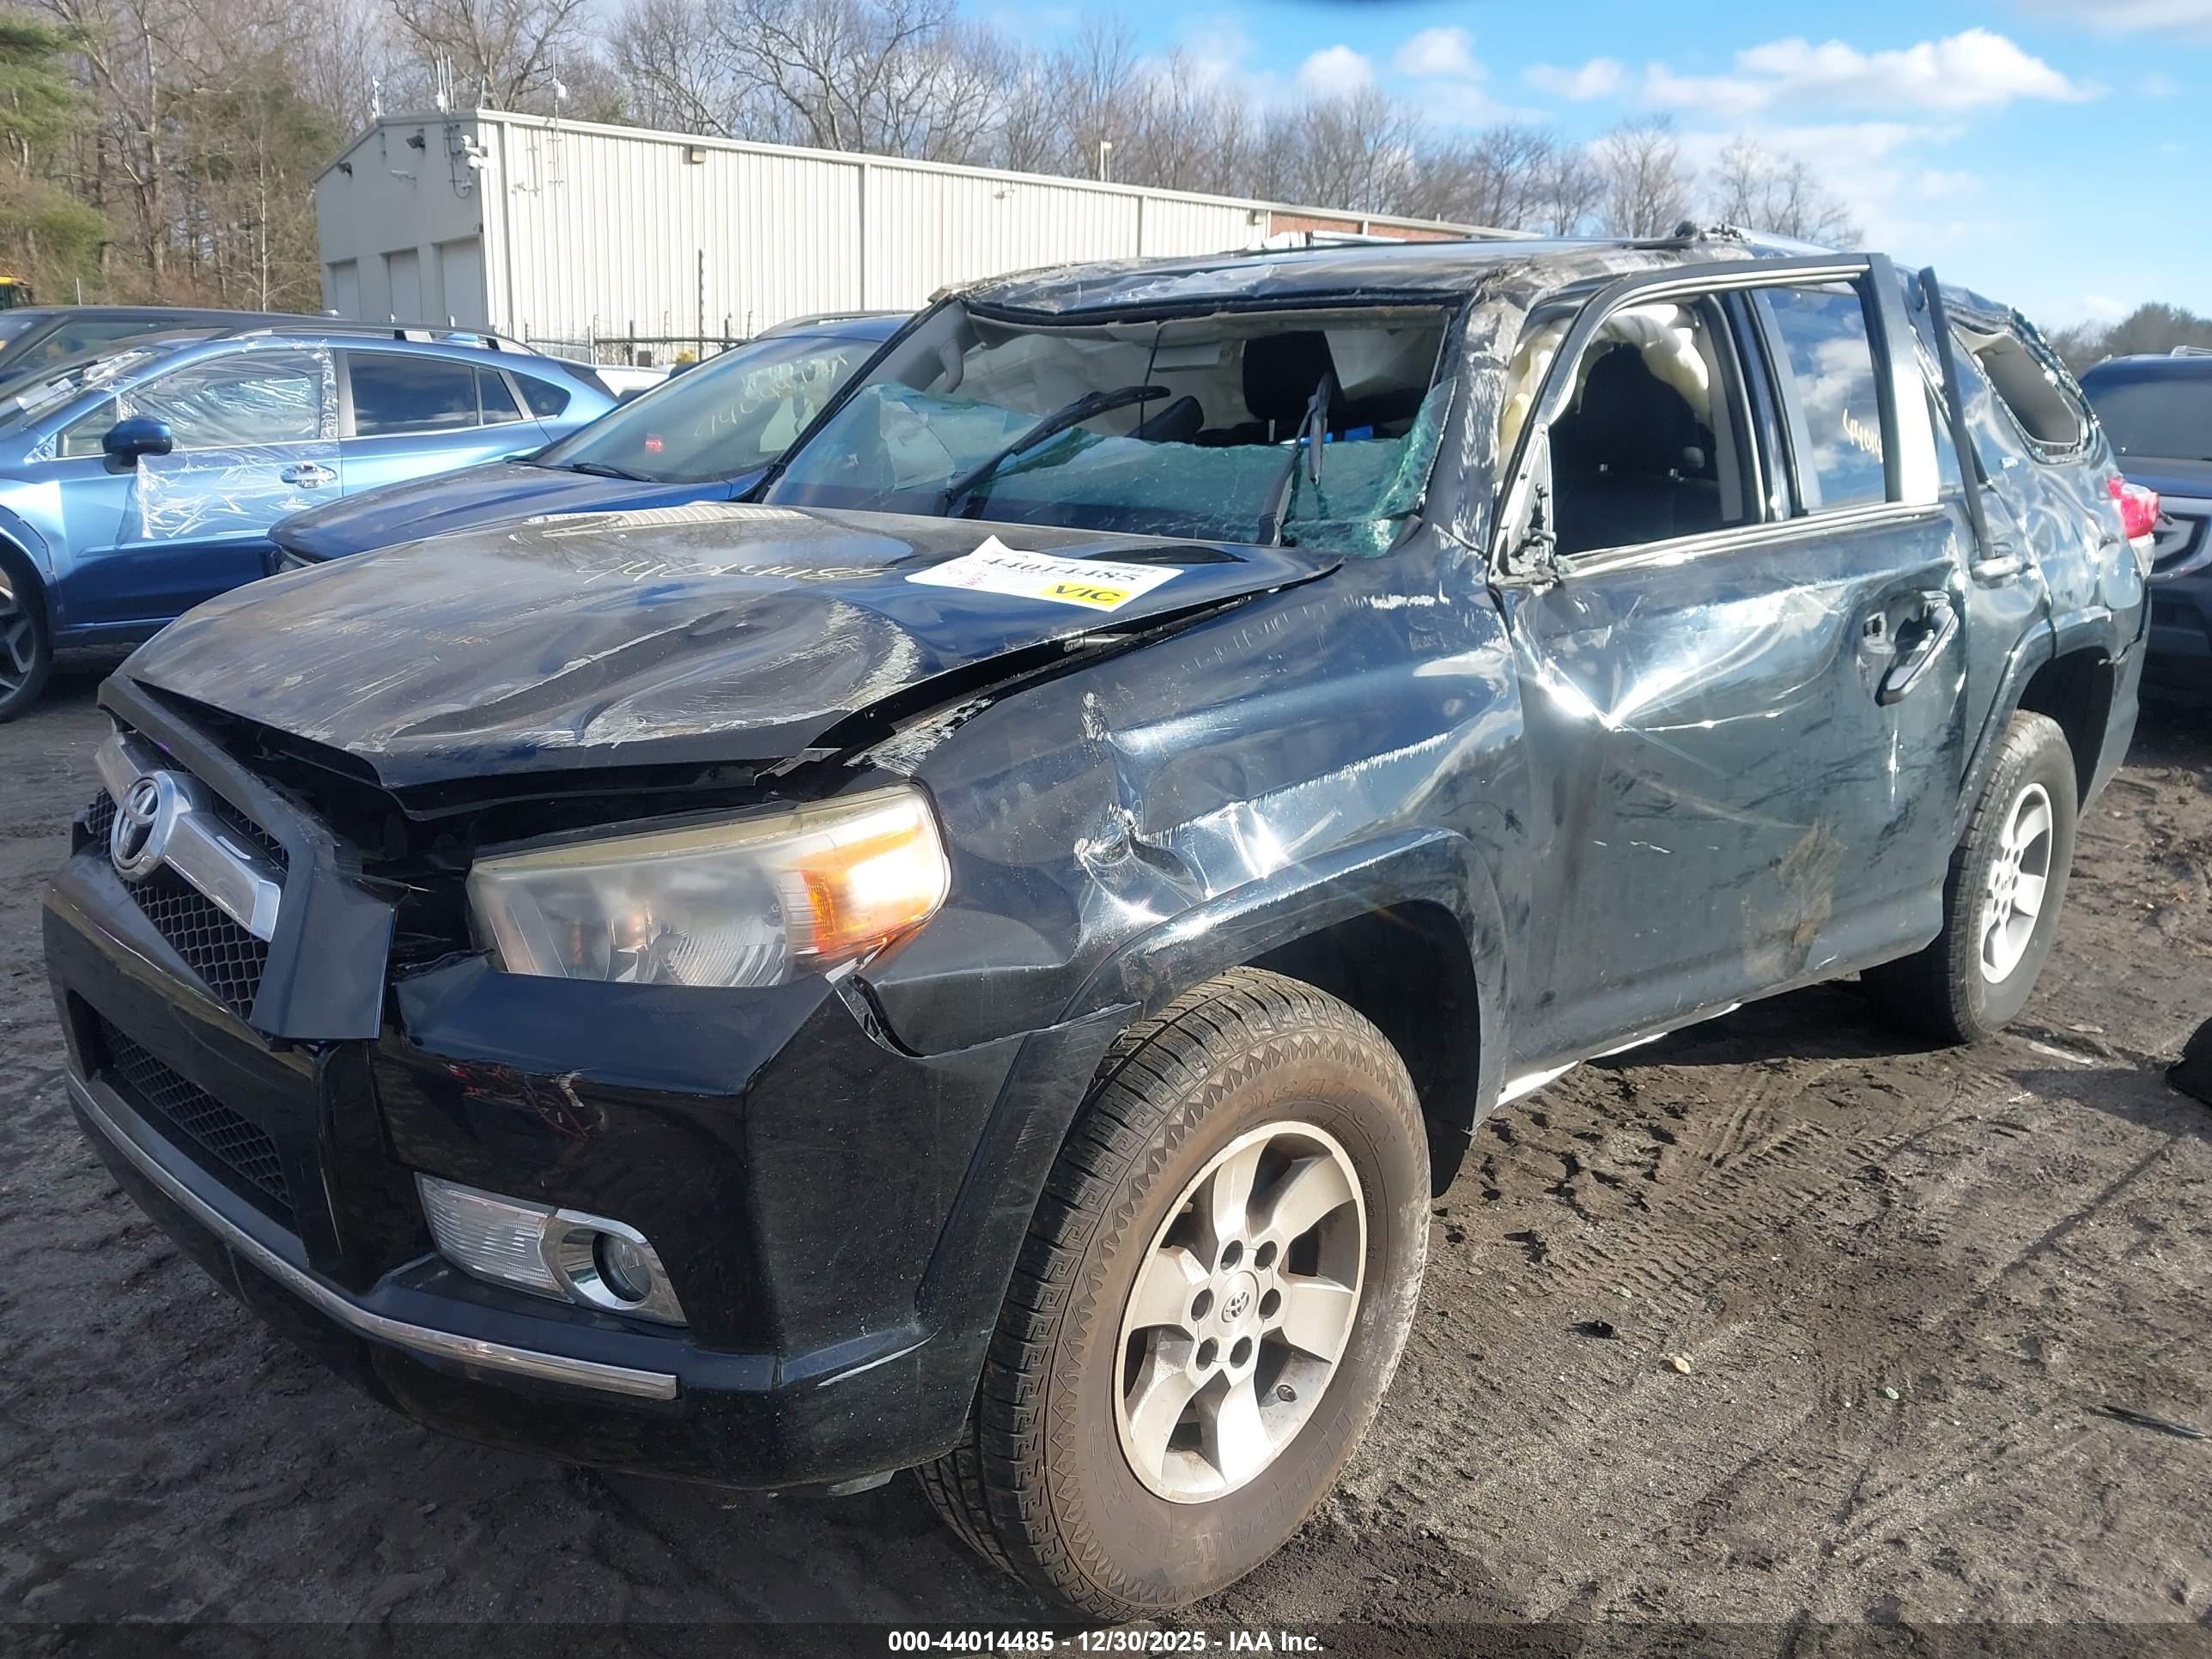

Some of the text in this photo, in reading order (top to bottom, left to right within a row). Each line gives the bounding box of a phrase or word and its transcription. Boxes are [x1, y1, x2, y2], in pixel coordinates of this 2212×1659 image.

[576, 556, 898, 585] 44014485
[981, 558, 1139, 582] 44014485
[1054, 584, 1121, 603] VIC
